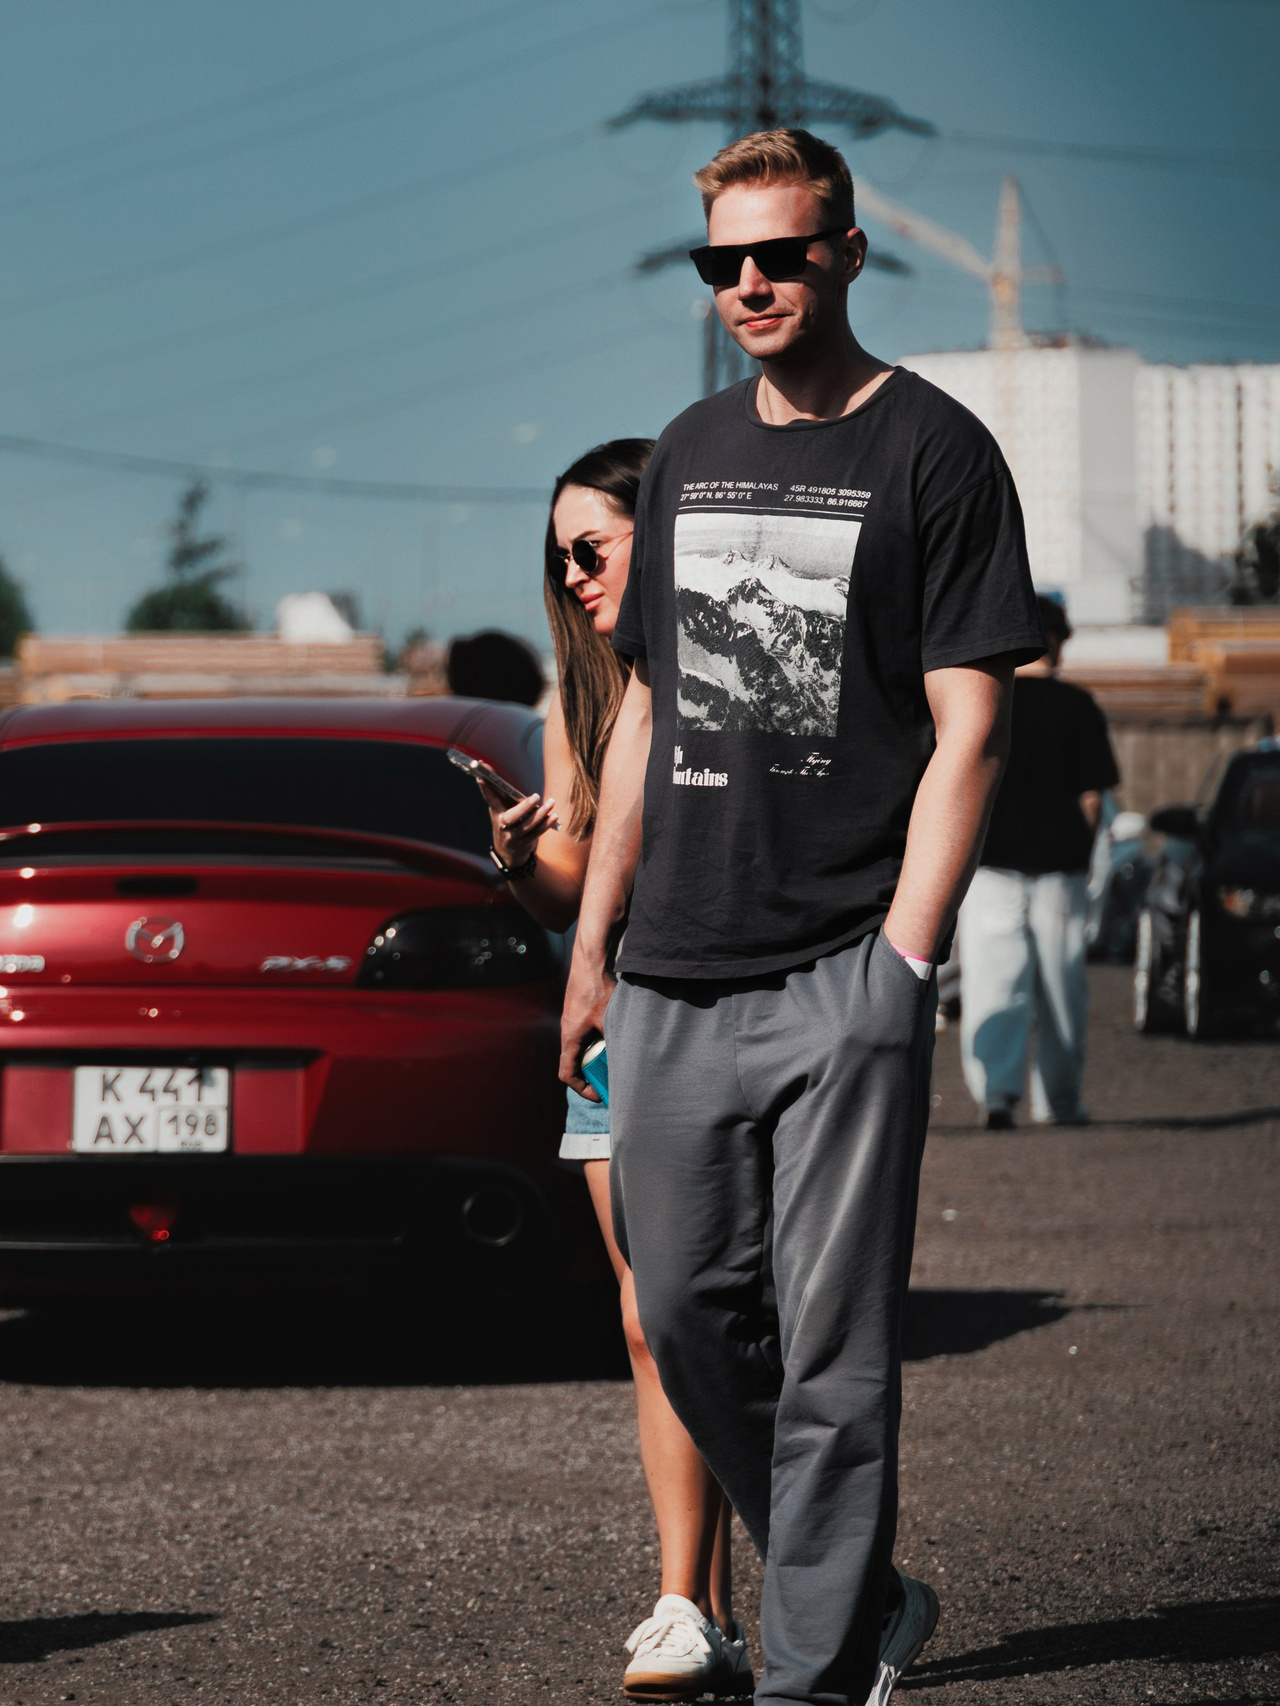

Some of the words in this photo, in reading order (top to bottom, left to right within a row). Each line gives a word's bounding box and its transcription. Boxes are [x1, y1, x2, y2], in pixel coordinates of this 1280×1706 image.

[683, 483, 696, 491] THE
[695, 481, 709, 490] ARC
[709, 481, 721, 489] OF
[721, 481, 735, 489] THE
[735, 481, 779, 491] HIMALAYAS
[790, 484, 807, 493] 45R
[807, 486, 837, 496] 491805
[746, 492, 752, 500] E
[101, 1071, 122, 1102] K
[138, 1071, 204, 1102] 441
[93, 1115, 145, 1145] AX
[167, 1113, 218, 1136] 198
